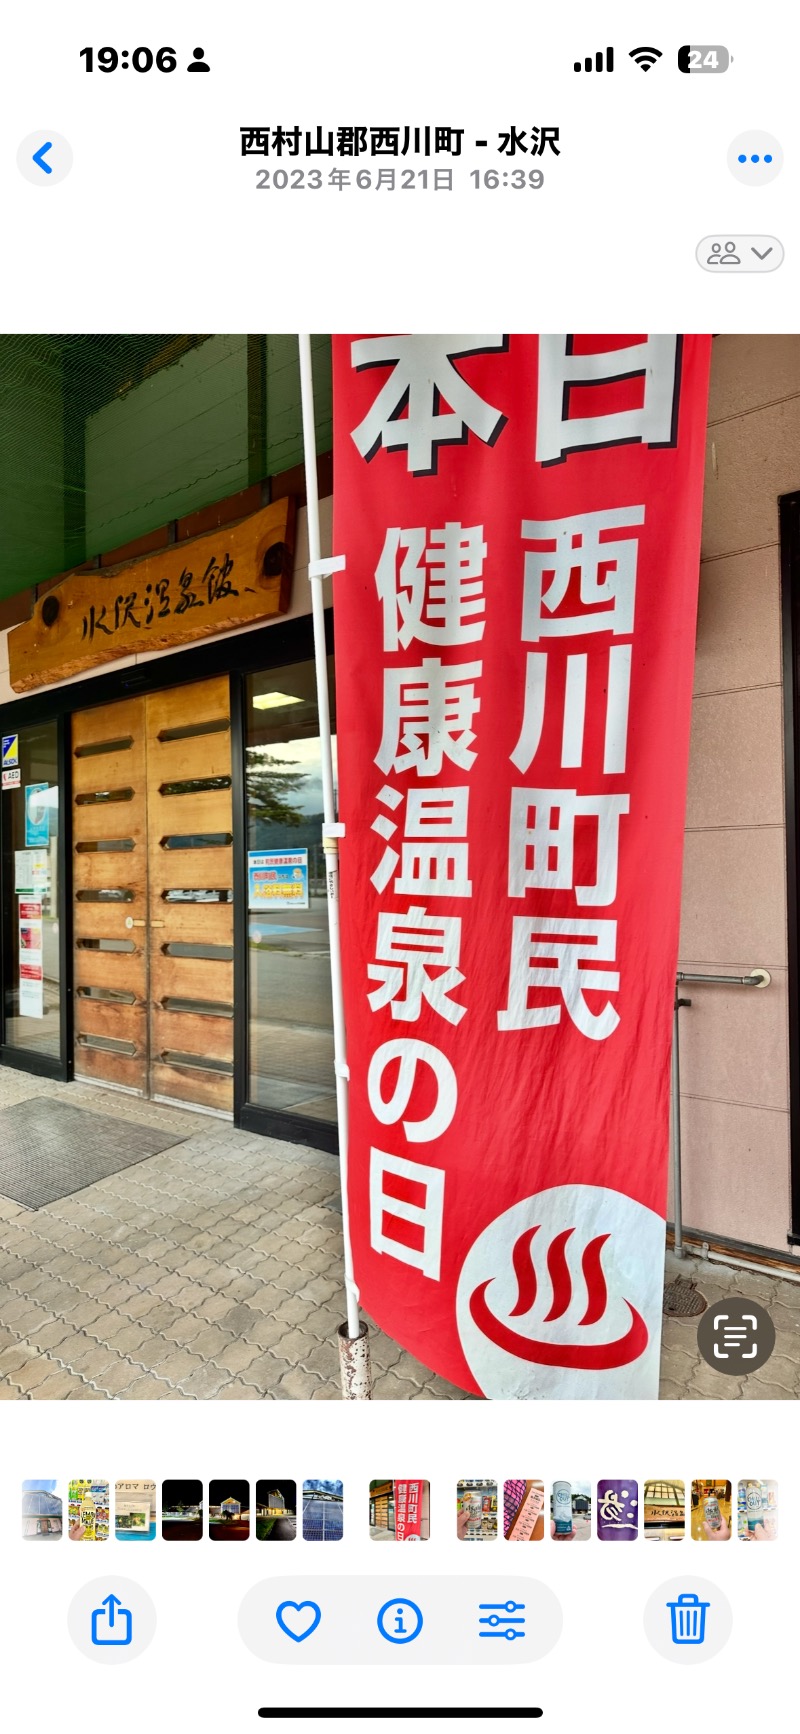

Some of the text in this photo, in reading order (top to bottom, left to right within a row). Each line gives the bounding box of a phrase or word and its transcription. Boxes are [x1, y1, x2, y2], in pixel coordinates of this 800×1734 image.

[8, 771, 19, 780] AED
[366, 521, 488, 1282] 健康温泉の日
[496, 504, 646, 1041] 西川町民
[407, 1483, 419, 1523] 西川町民
